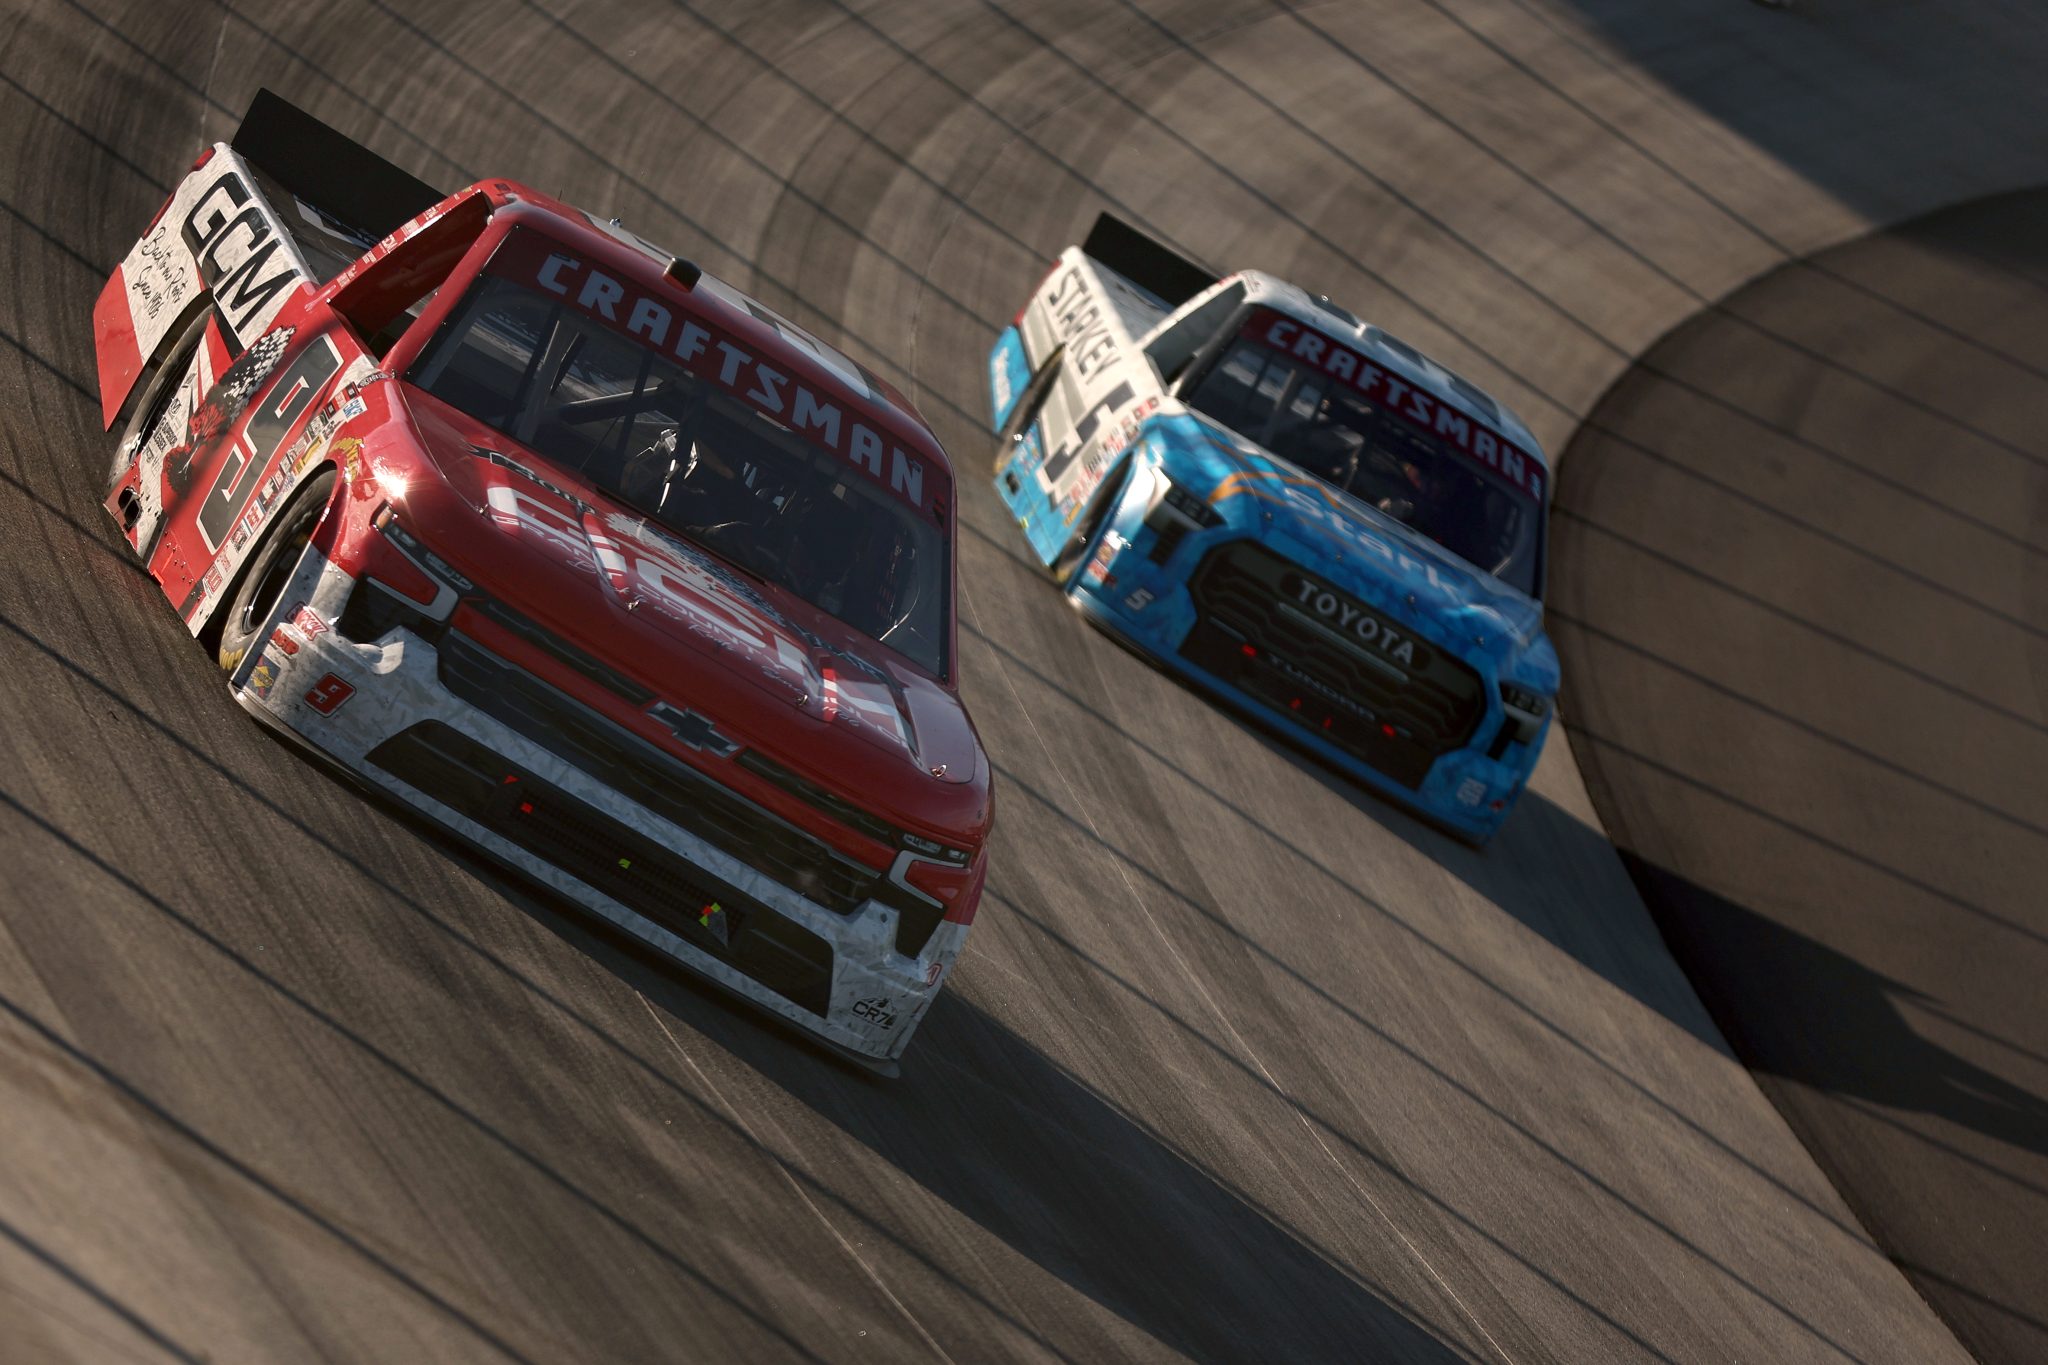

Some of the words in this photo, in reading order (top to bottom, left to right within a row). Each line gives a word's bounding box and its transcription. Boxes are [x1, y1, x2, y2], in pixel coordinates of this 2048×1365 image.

[181, 172, 303, 335] GCM
[1048, 266, 1121, 386] STARKEY
[537, 253, 924, 509] CRAFTSMAN
[1265, 320, 1527, 483] CRAFTSMAN
[637, 582, 789, 671] COUNTY
[1124, 587, 1155, 611] 5
[1297, 579, 1415, 666] TOYOTA
[304, 671, 358, 719] 9
